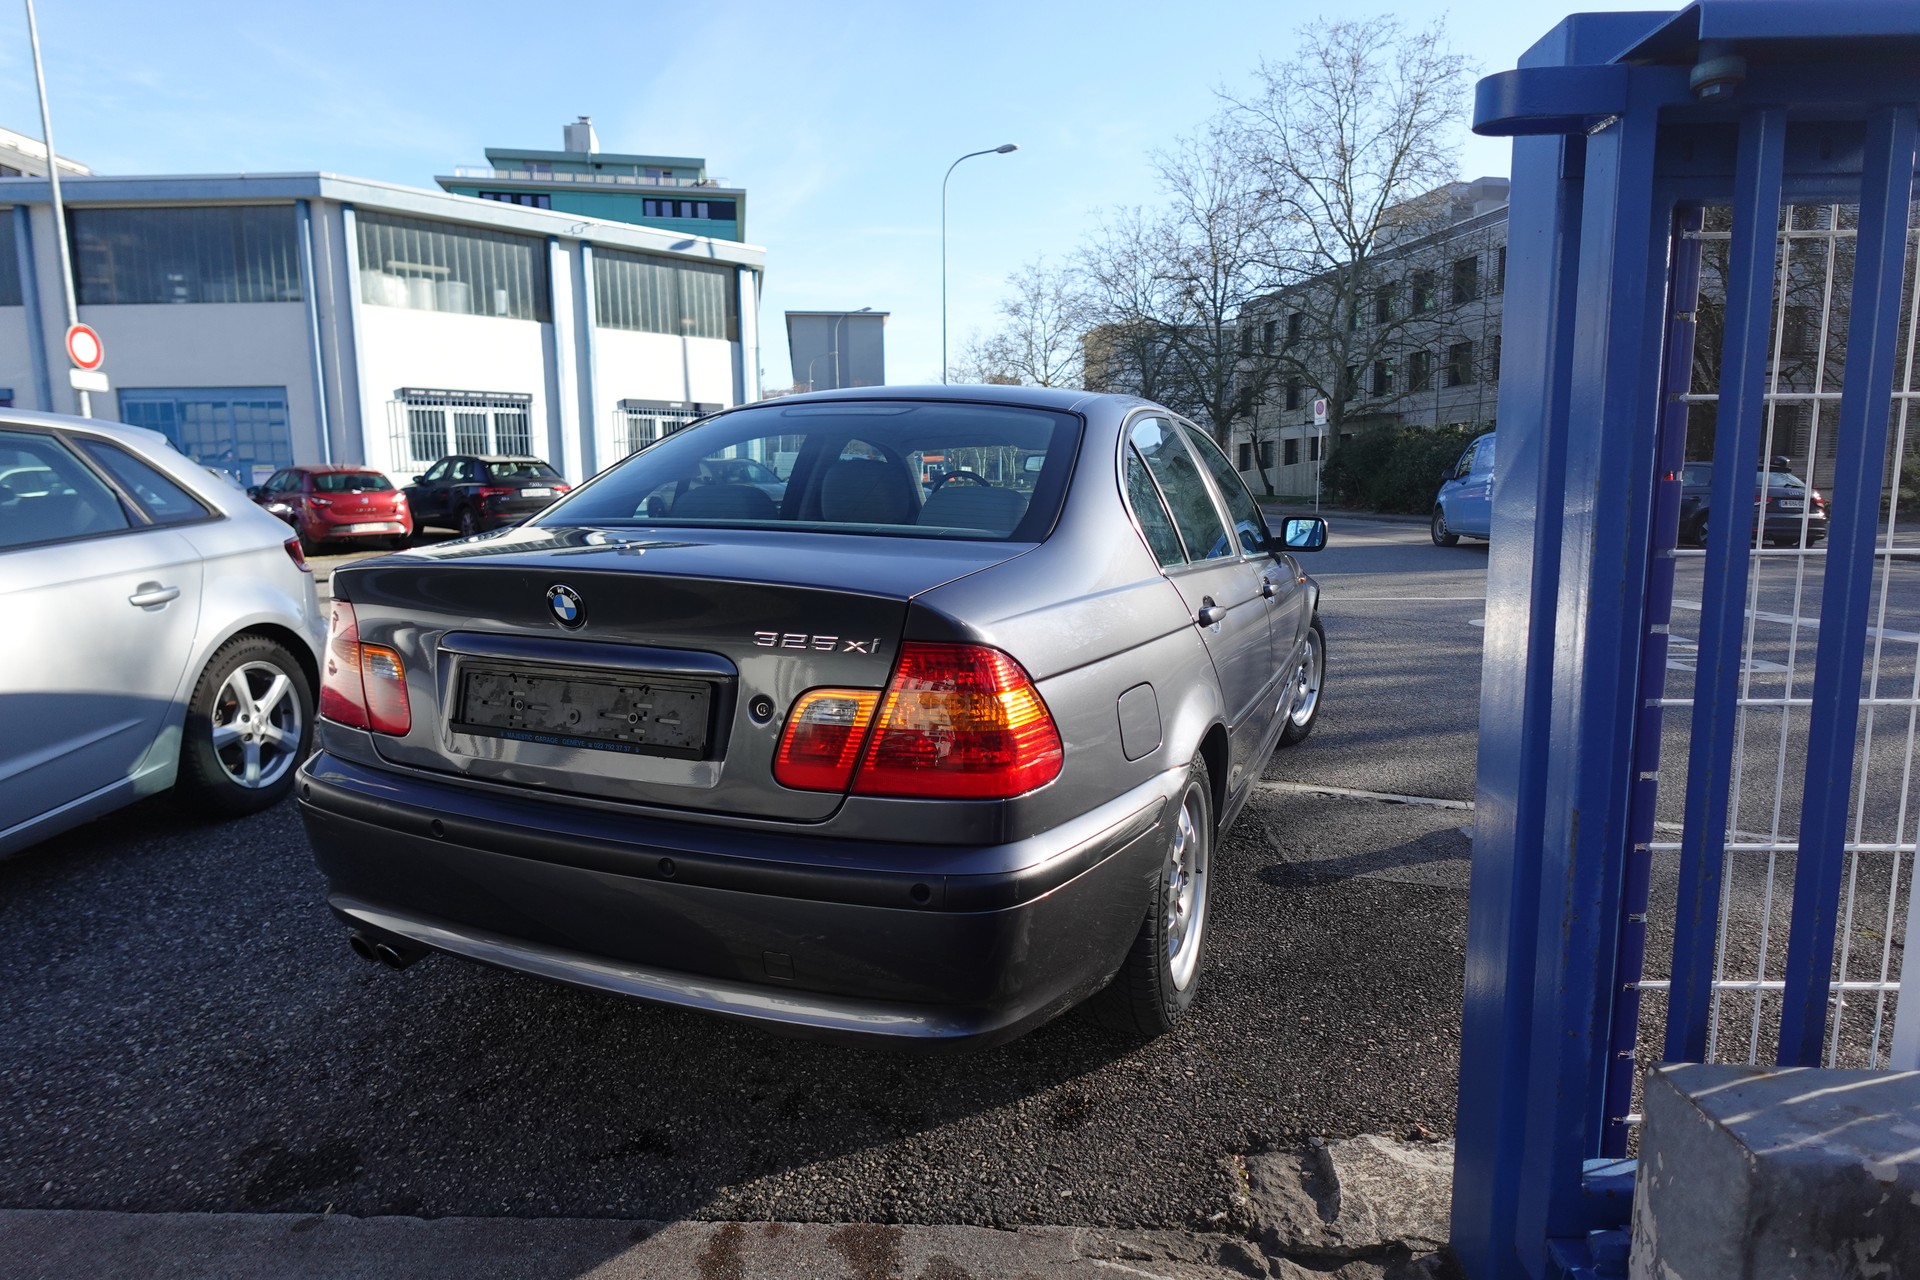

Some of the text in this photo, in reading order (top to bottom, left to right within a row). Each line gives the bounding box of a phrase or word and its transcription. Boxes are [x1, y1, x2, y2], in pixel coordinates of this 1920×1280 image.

[549, 587, 578, 601] BMW
[753, 631, 882, 654] 325xi
[507, 731, 533, 741] MAJESTIC
[535, 735, 558, 744] GARAGE
[594, 742, 604, 750] 022
